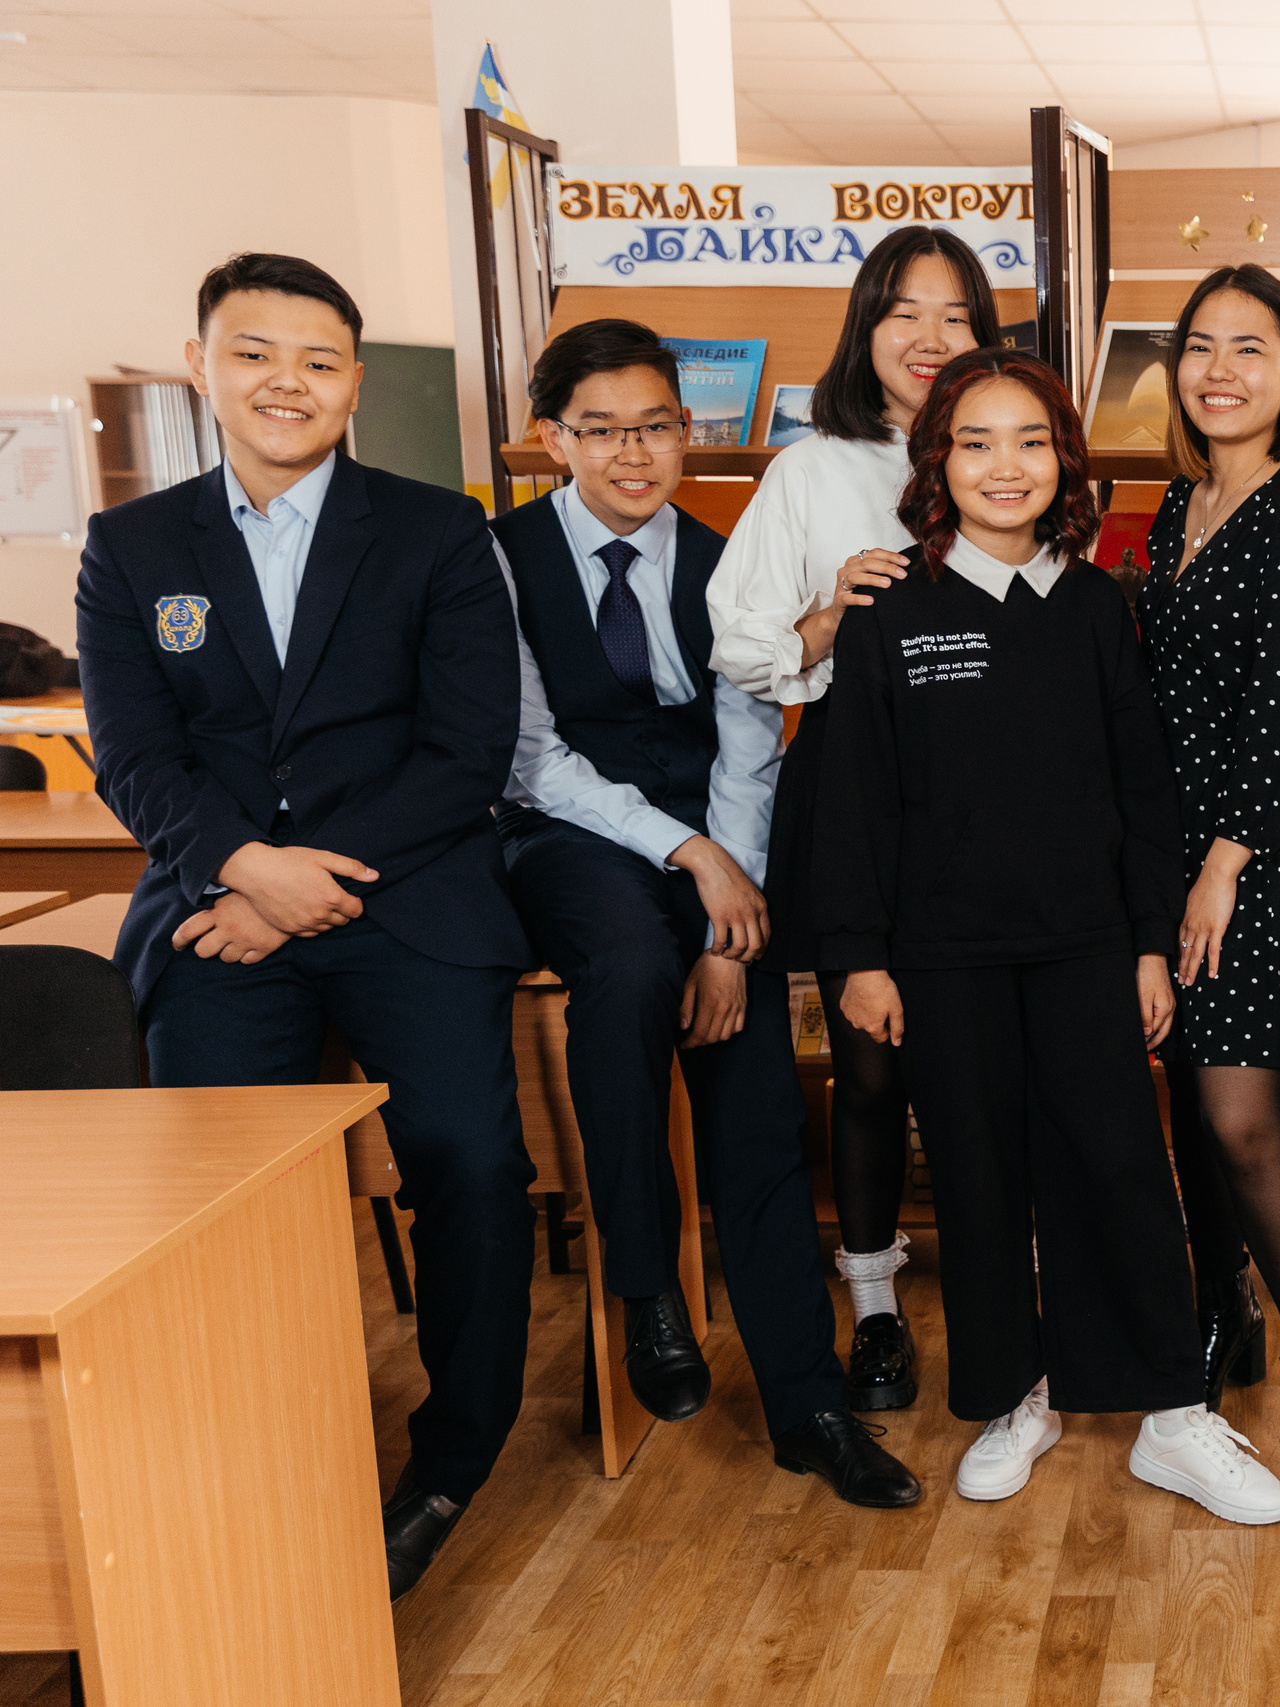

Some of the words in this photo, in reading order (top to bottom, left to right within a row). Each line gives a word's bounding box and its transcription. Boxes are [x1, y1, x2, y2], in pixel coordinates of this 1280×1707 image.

[558, 179, 745, 221] ЗЕМЛЯ
[625, 203, 893, 266] БАЙКА
[672, 347, 749, 360] АСЛЕДИЕ
[174, 610, 187, 621] 63
[901, 635, 935, 647] Studying
[936, 634, 944, 642] is
[945, 633, 961, 642] not
[962, 632, 987, 641] about
[922, 644, 937, 653] It's
[938, 642, 965, 652] about
[965, 640, 991, 649] effort.
[952, 661, 963, 669] не
